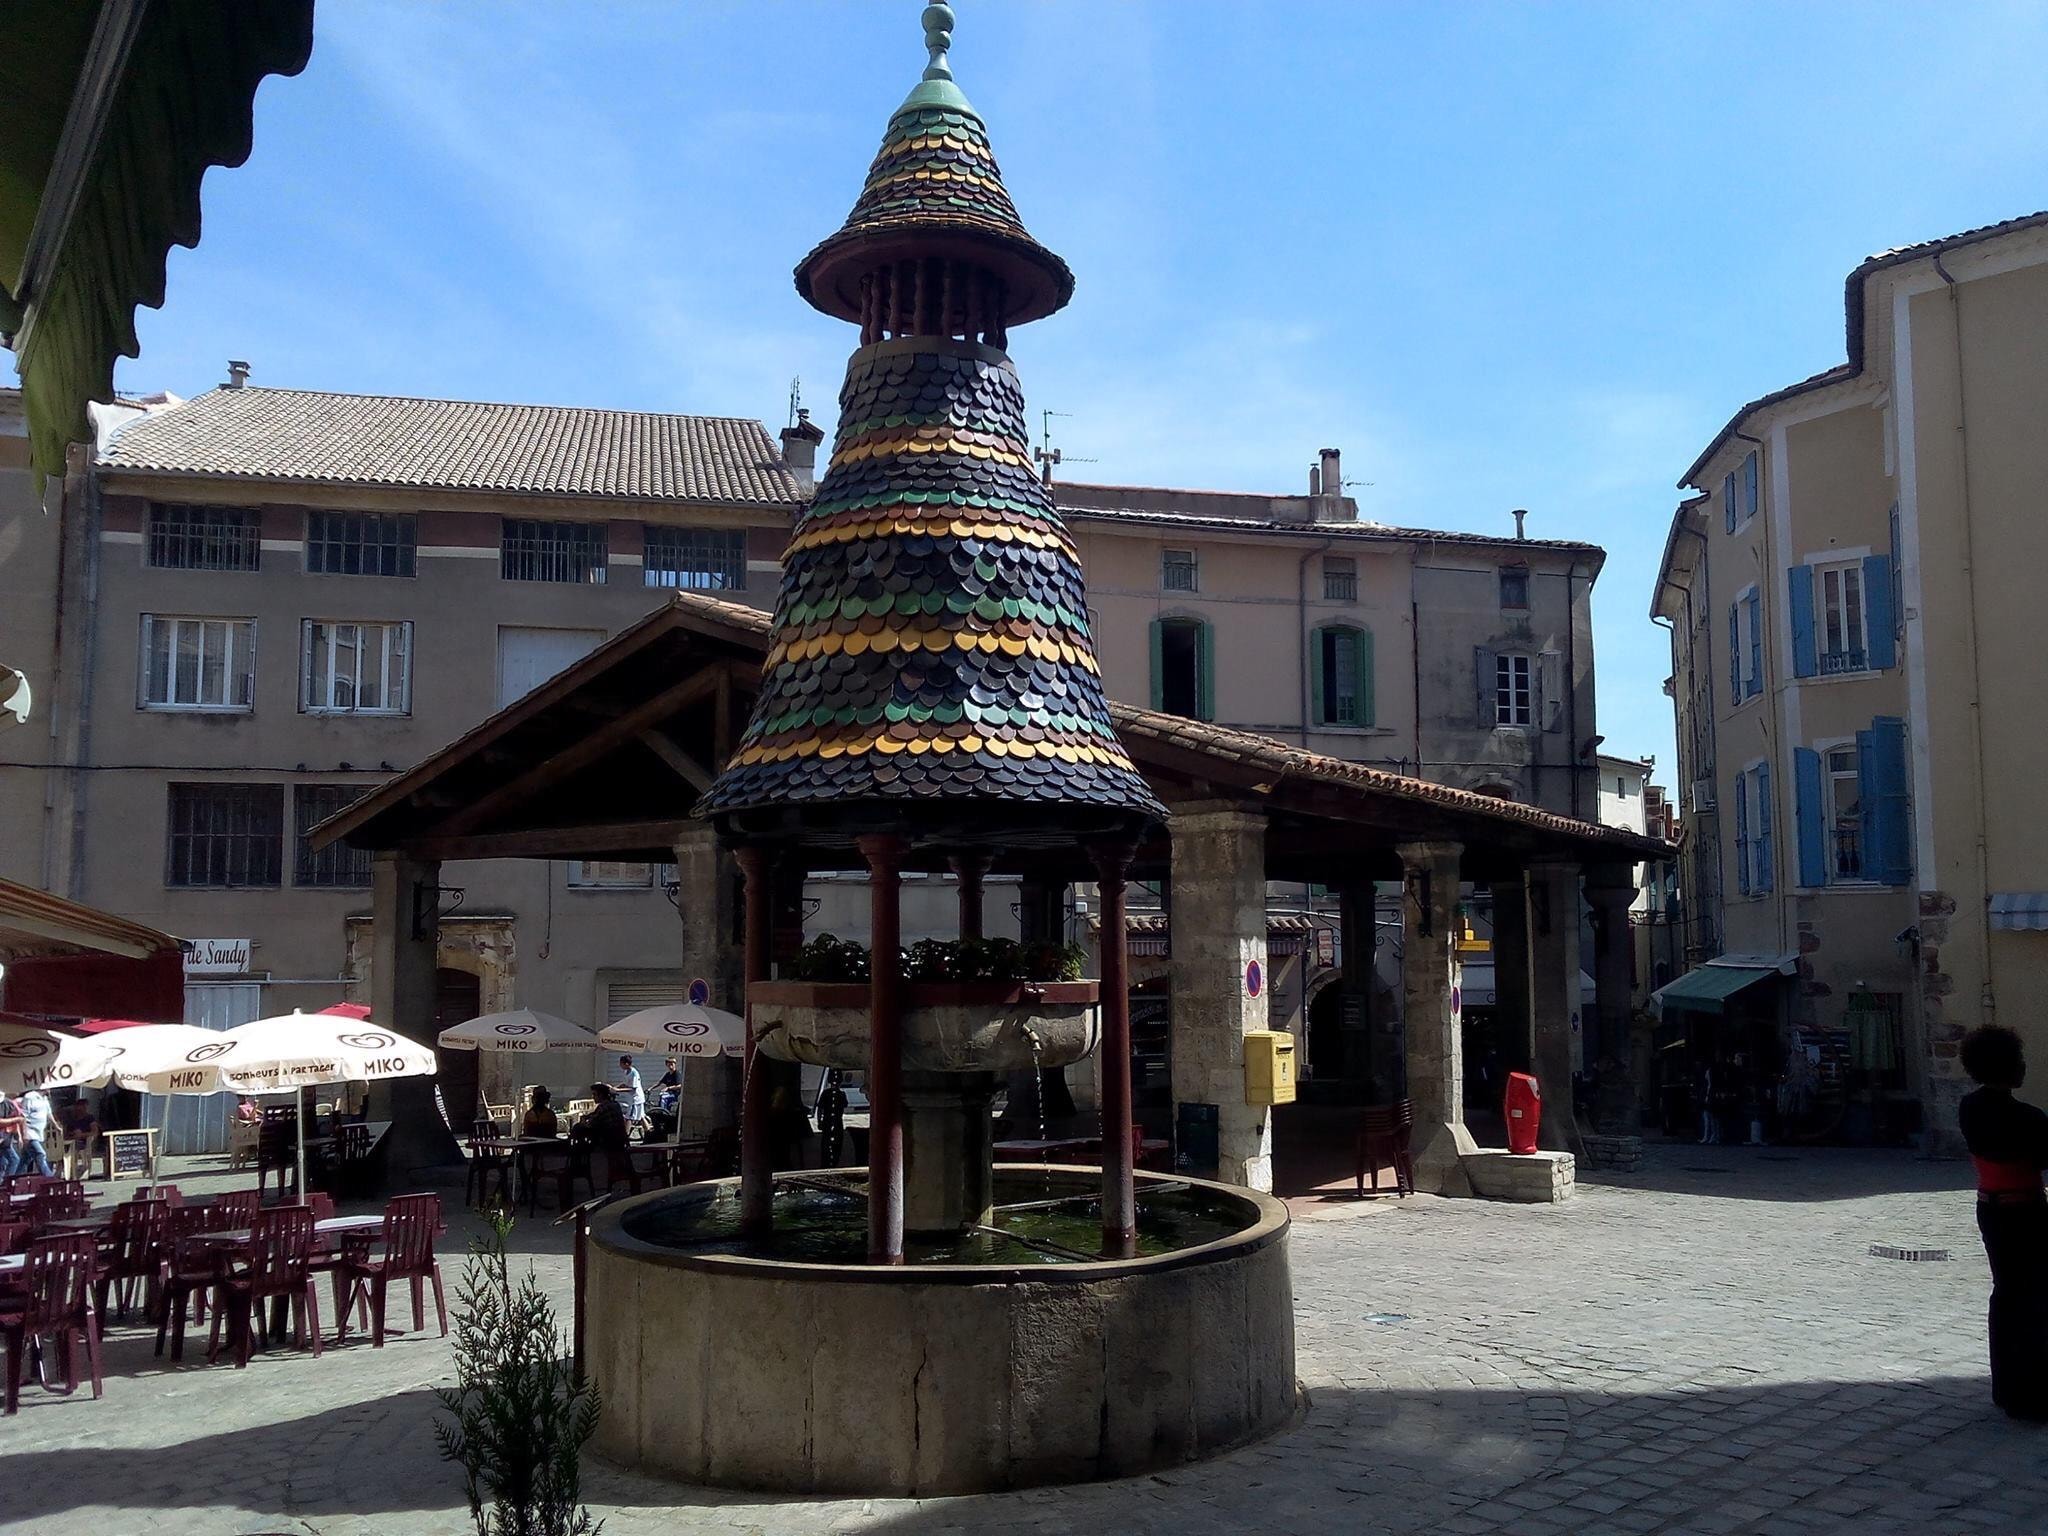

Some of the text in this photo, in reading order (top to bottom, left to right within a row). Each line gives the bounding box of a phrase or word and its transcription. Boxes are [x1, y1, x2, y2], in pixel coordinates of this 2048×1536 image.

[187, 940, 247, 972] de Sandy
[496, 1039, 528, 1050] MIKO
[668, 1042, 703, 1054] MIKO
[364, 1057, 406, 1075] MIKO
[22, 1064, 73, 1088] MIKO
[169, 1071, 204, 1089] MIKO
